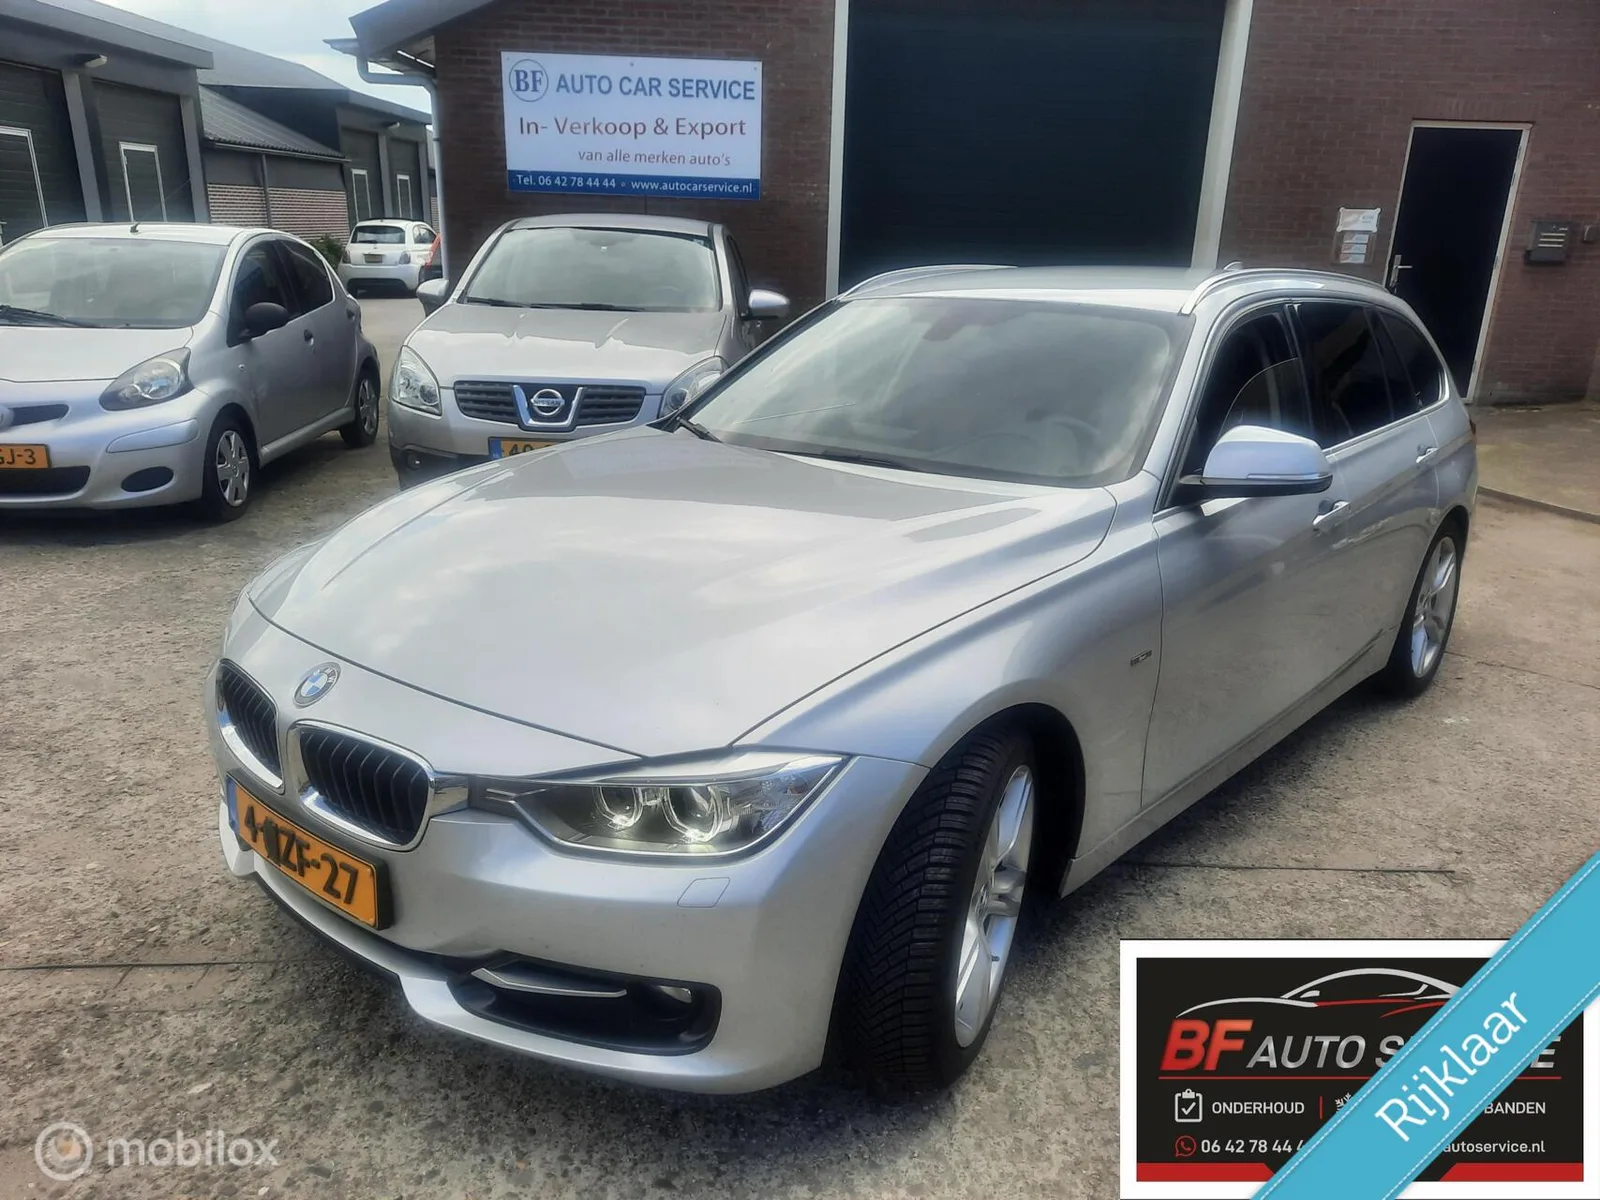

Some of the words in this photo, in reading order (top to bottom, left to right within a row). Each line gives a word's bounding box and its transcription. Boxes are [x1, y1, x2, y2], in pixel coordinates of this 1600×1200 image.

[513, 69, 545, 93] BF
[555, 73, 613, 95] AUTO
[619, 76, 662, 97] CAR
[668, 78, 755, 100] SERVICE
[519, 117, 548, 135] In-
[554, 117, 646, 140] Verkoop
[653, 117, 668, 136] &
[676, 117, 746, 140] Export
[578, 150, 603, 162] van
[606, 149, 630, 163] alle
[634, 150, 686, 165] merken
[689, 152, 731, 166] auto's
[516, 174, 536, 186] Tel.
[538, 175, 552, 186] 06
[554, 176, 568, 187] 42
[571, 176, 584, 188] 78
[586, 177, 600, 188] 44
[602, 178, 616, 189] 44
[631, 180, 753, 194] www.autocarservice.nl
